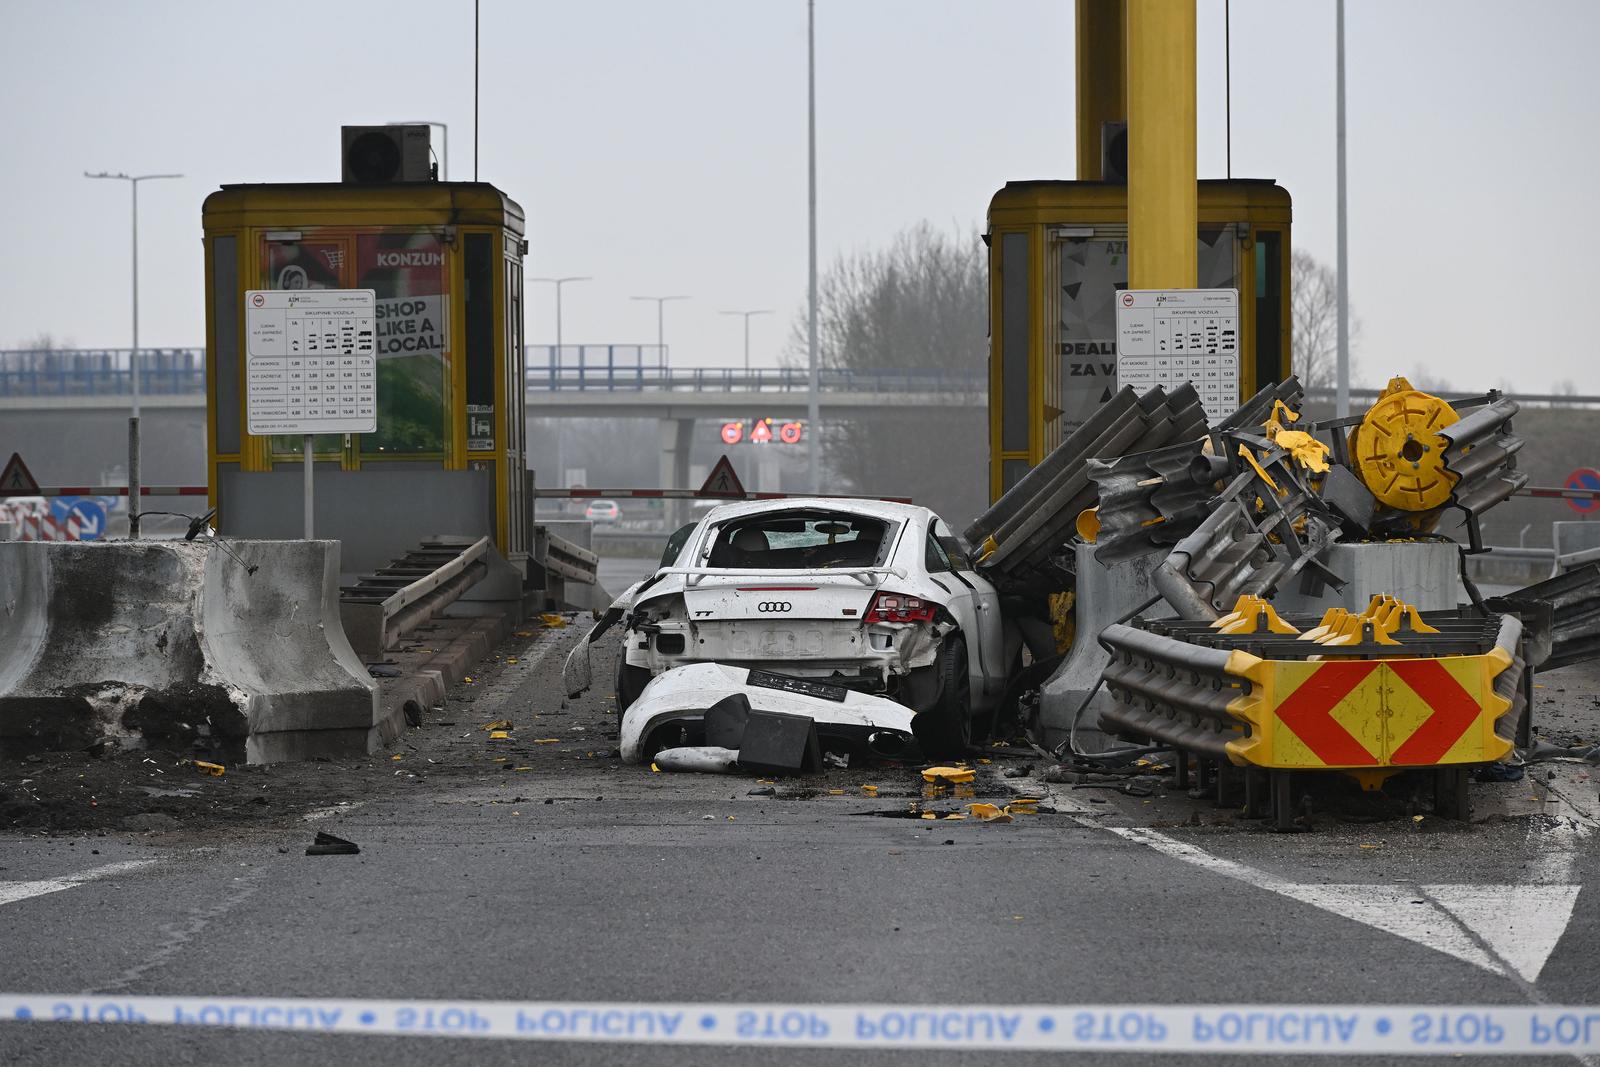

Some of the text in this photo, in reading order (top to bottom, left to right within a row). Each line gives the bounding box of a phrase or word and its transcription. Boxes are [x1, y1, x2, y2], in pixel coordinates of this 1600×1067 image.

[377, 252, 445, 266] KONZUM
[376, 301, 426, 319] SHOP
[376, 318, 434, 336] LIKE A
[377, 334, 445, 354] LOCAL!
[1071, 363, 1116, 376] ZA V
